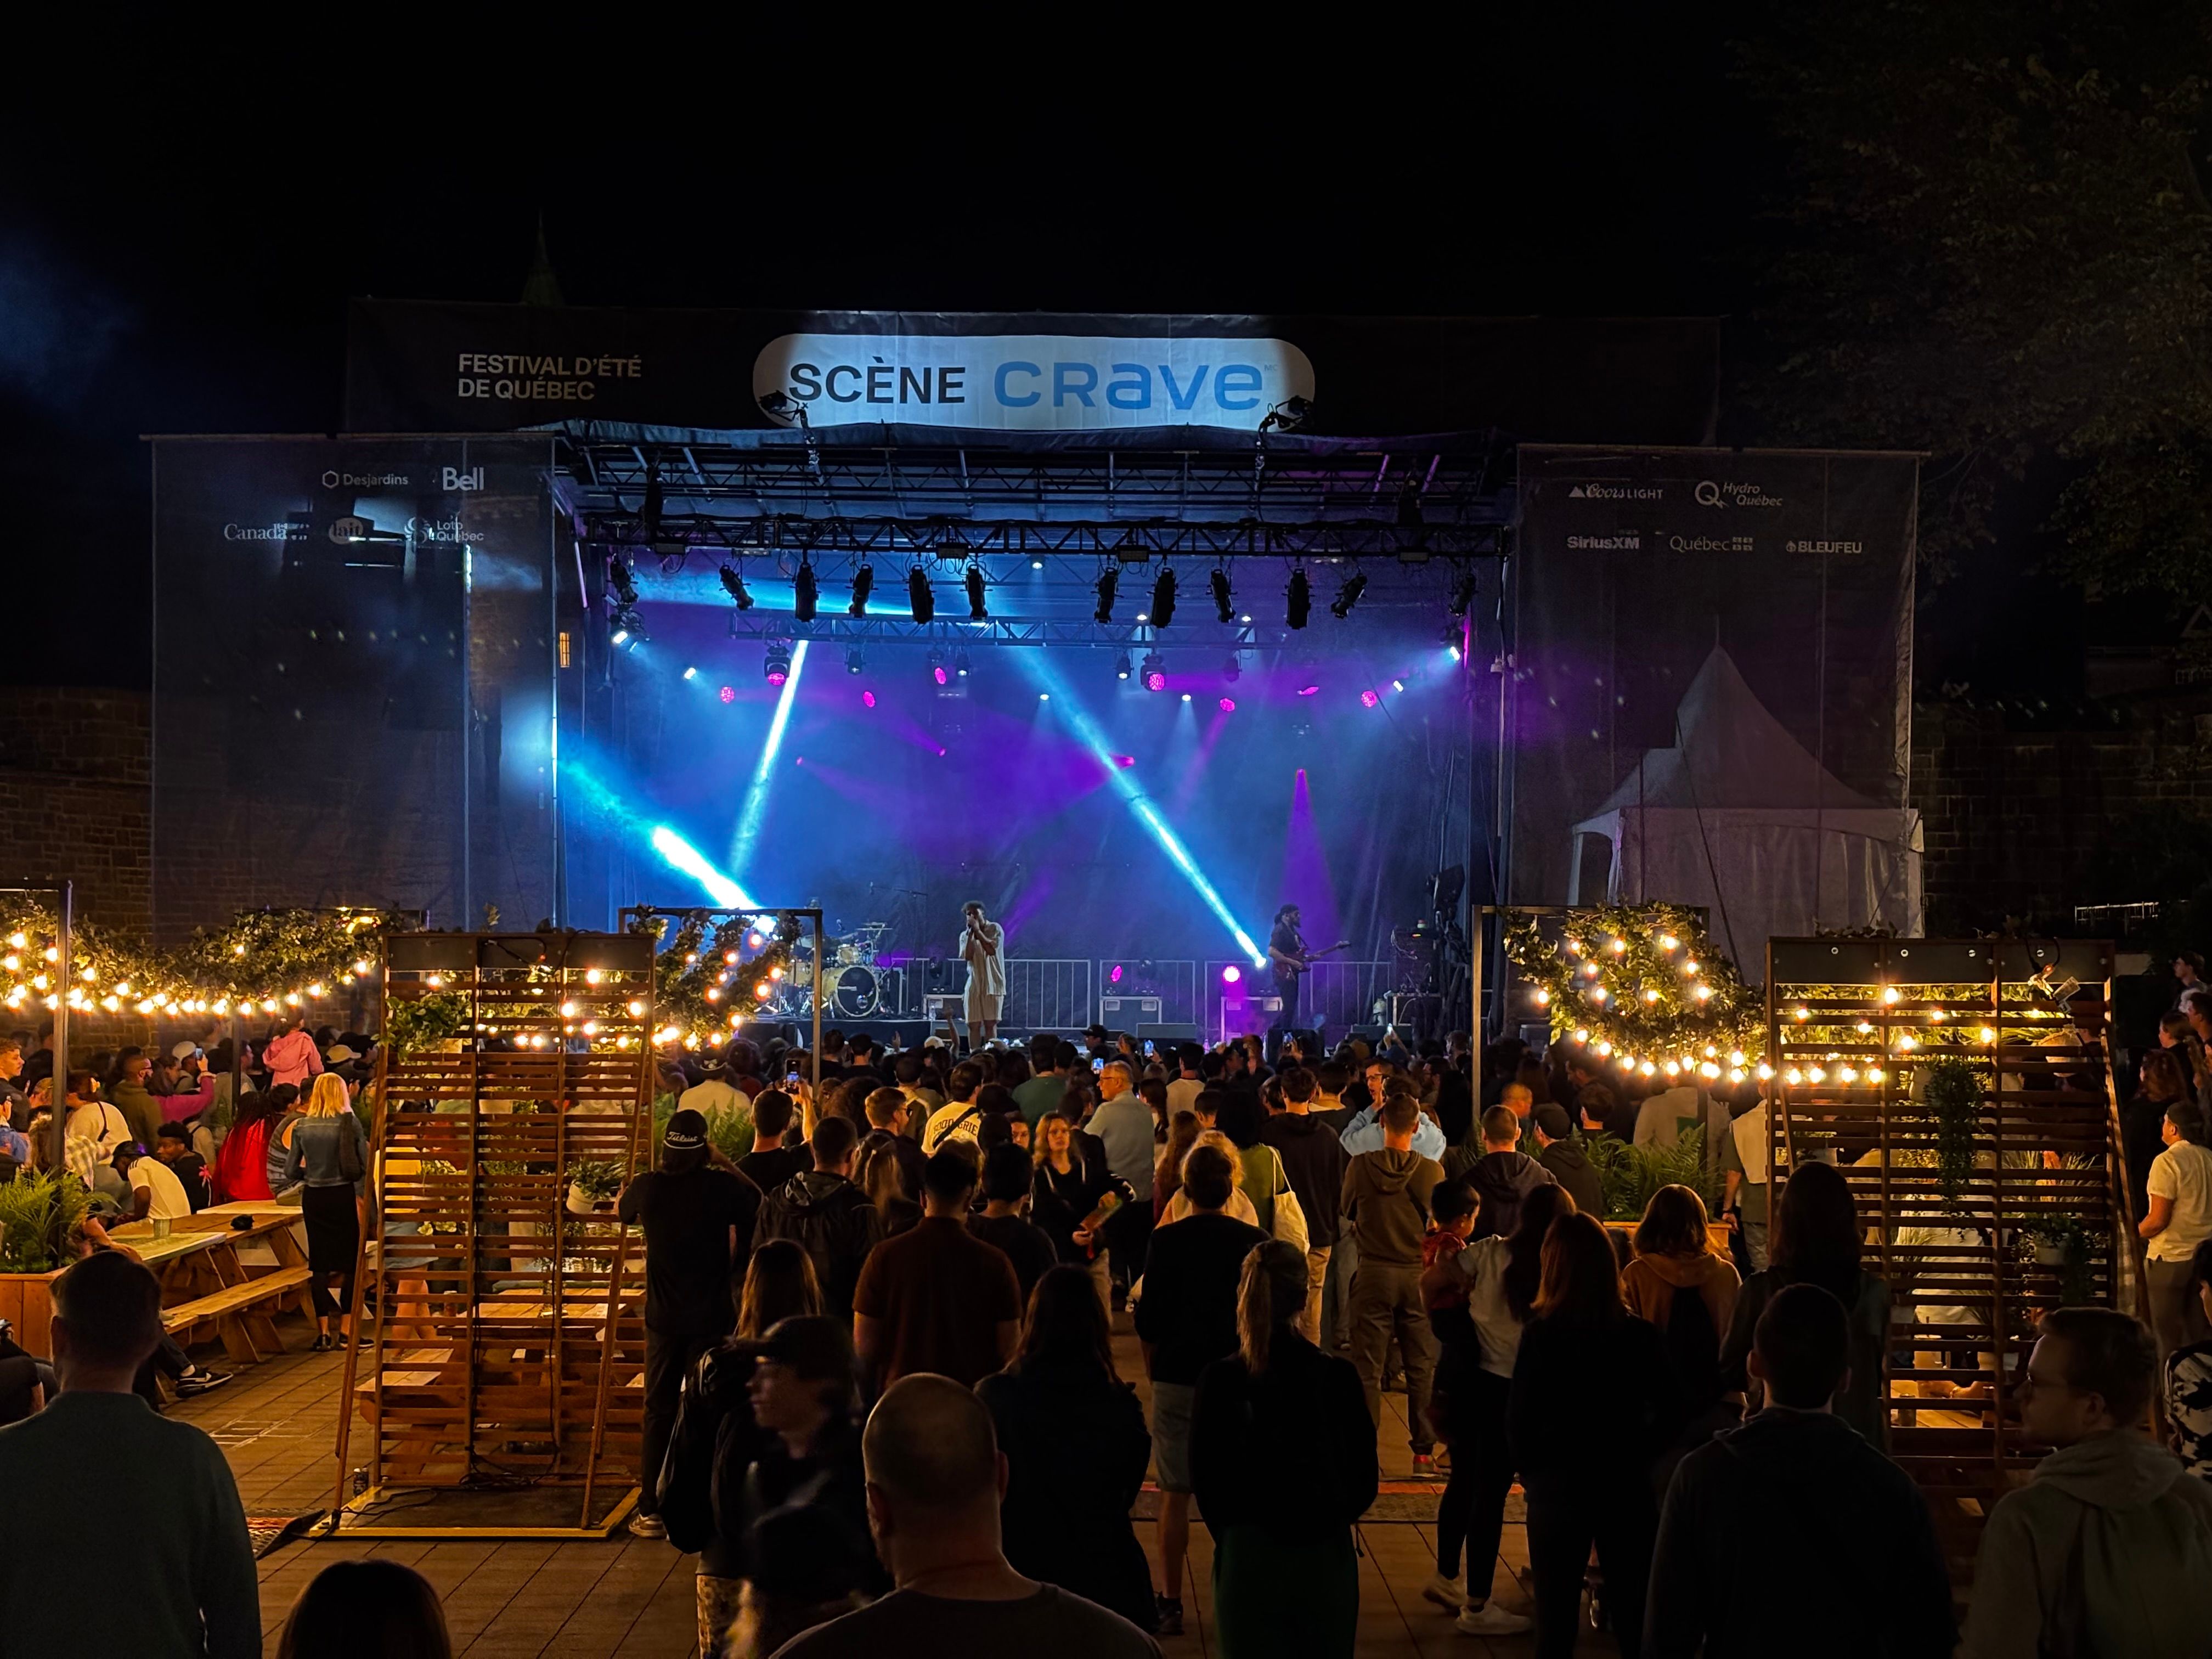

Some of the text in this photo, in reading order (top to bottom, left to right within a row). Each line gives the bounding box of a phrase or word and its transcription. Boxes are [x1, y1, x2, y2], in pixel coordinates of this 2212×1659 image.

[459, 354, 642, 377] FESTIVAL D'ÉTÉ
[789, 356, 966, 404] SCÈNE
[458, 377, 595, 400] DE QUÉBEC
[343, 473, 409, 487] Desjardins
[442, 467, 484, 490] Bell
[1586, 483, 1663, 499] Coors LIGHT
[1723, 482, 1760, 495] Hydro
[1736, 494, 1782, 506] Québec
[224, 523, 287, 540] Canada
[333, 521, 359, 538] lait
[437, 520, 464, 531] Loto
[1567, 536, 1639, 550] SiriusXM
[1669, 535, 1730, 553] Québec
[1798, 541, 1862, 554] BLEUFEU
